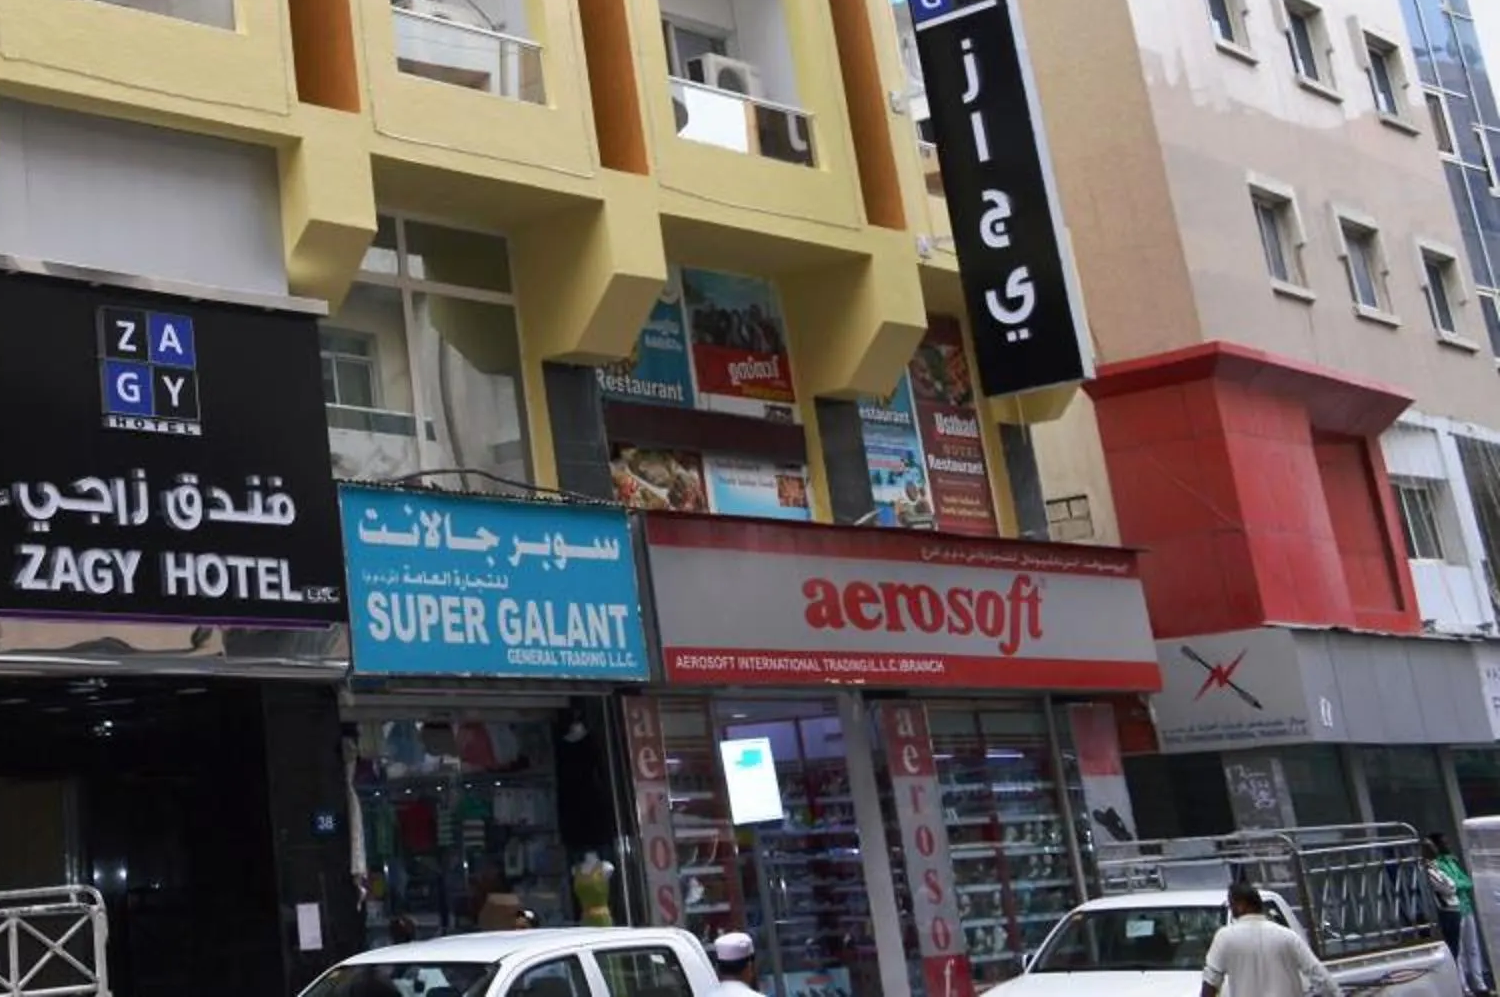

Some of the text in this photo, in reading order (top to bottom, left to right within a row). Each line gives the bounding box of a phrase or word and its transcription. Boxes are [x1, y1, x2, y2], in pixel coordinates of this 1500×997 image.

[596, 368, 684, 401] Restaurant
[112, 416, 198, 435] HOTEL
[11, 468, 296, 532] فندق زاجي
[357, 503, 621, 571] سوبر جالانت
[14, 544, 142, 595] ZAGY
[161, 550, 303, 602] HOTEL
[366, 591, 630, 650] SUPER GALANT
[802, 573, 1045, 656] aerosoft
[507, 648, 559, 667] GENERAL
[560, 650, 607, 668] TRADING
[675, 654, 735, 671] AEROSOFT
[737, 655, 821, 673] INTERNATIONAL
